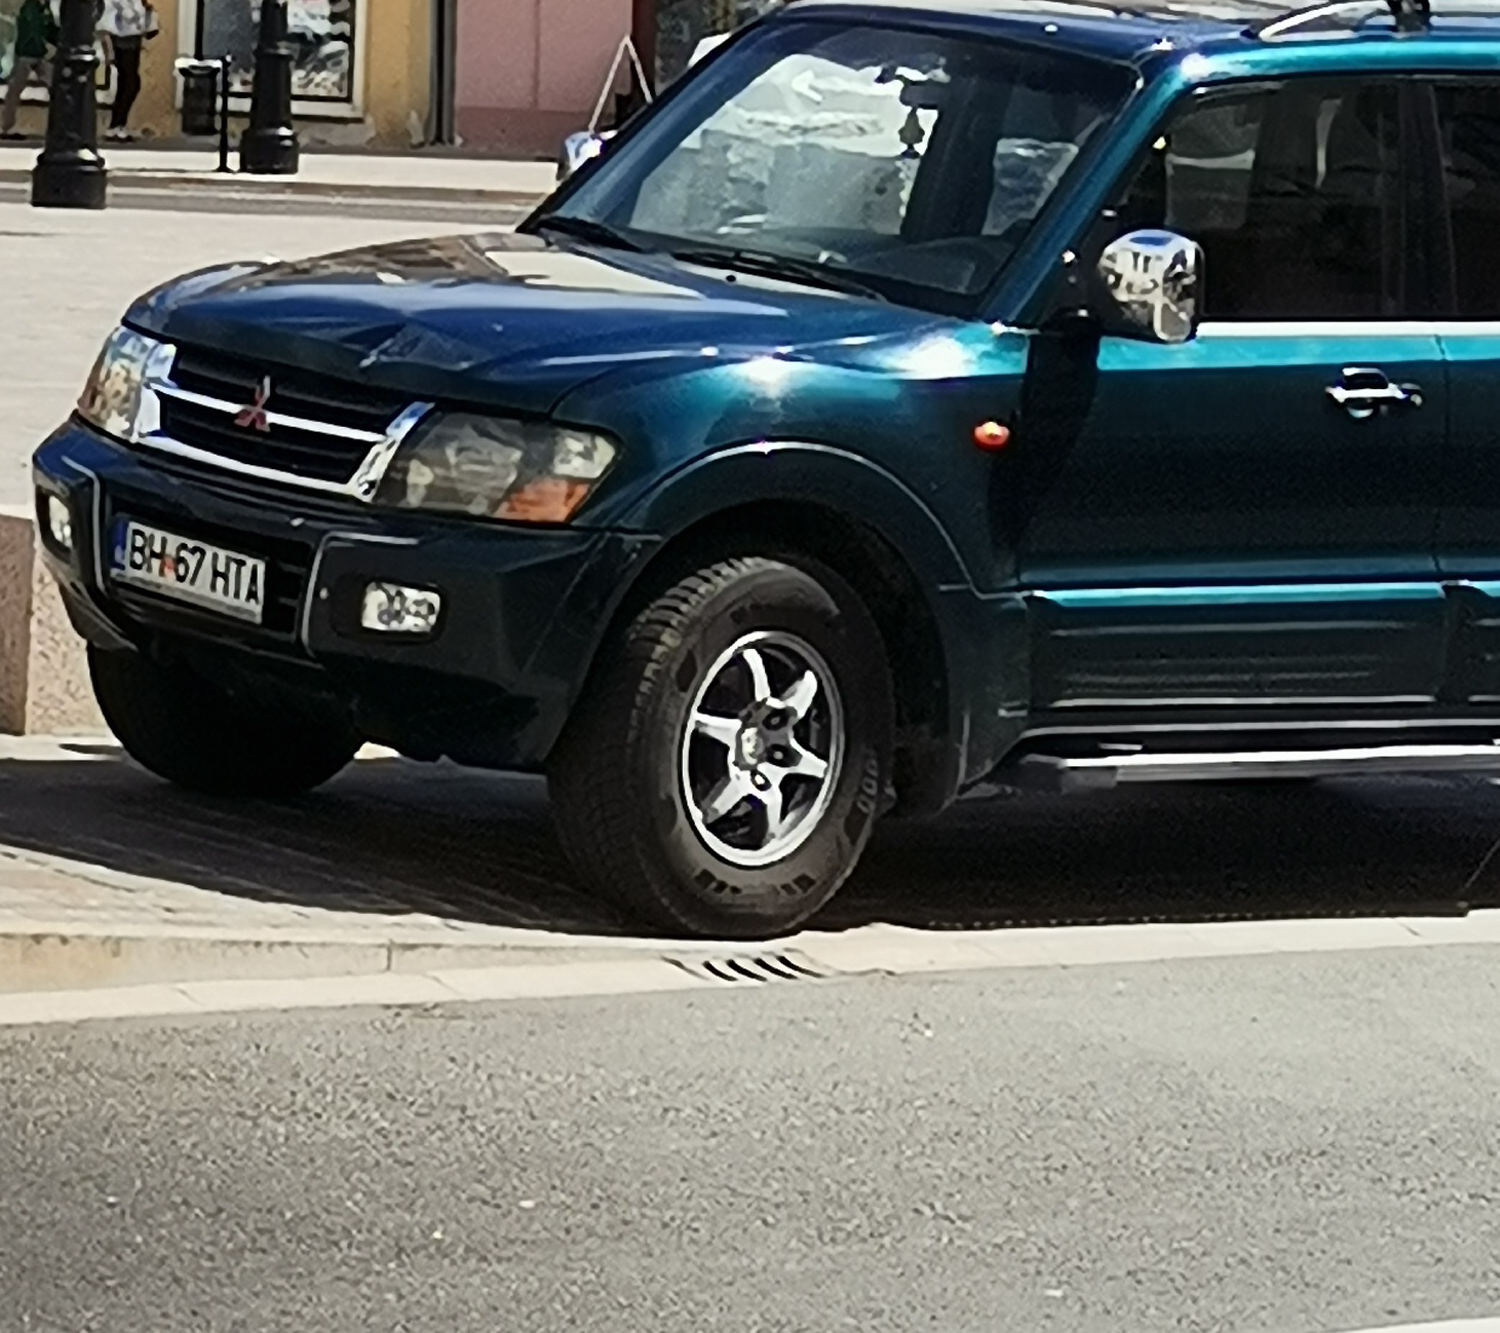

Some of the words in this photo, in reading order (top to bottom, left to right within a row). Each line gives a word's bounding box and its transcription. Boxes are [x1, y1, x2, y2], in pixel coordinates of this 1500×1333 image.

[129, 529, 167, 577] BH
[175, 542, 207, 587] 67
[210, 551, 260, 605] HTA
